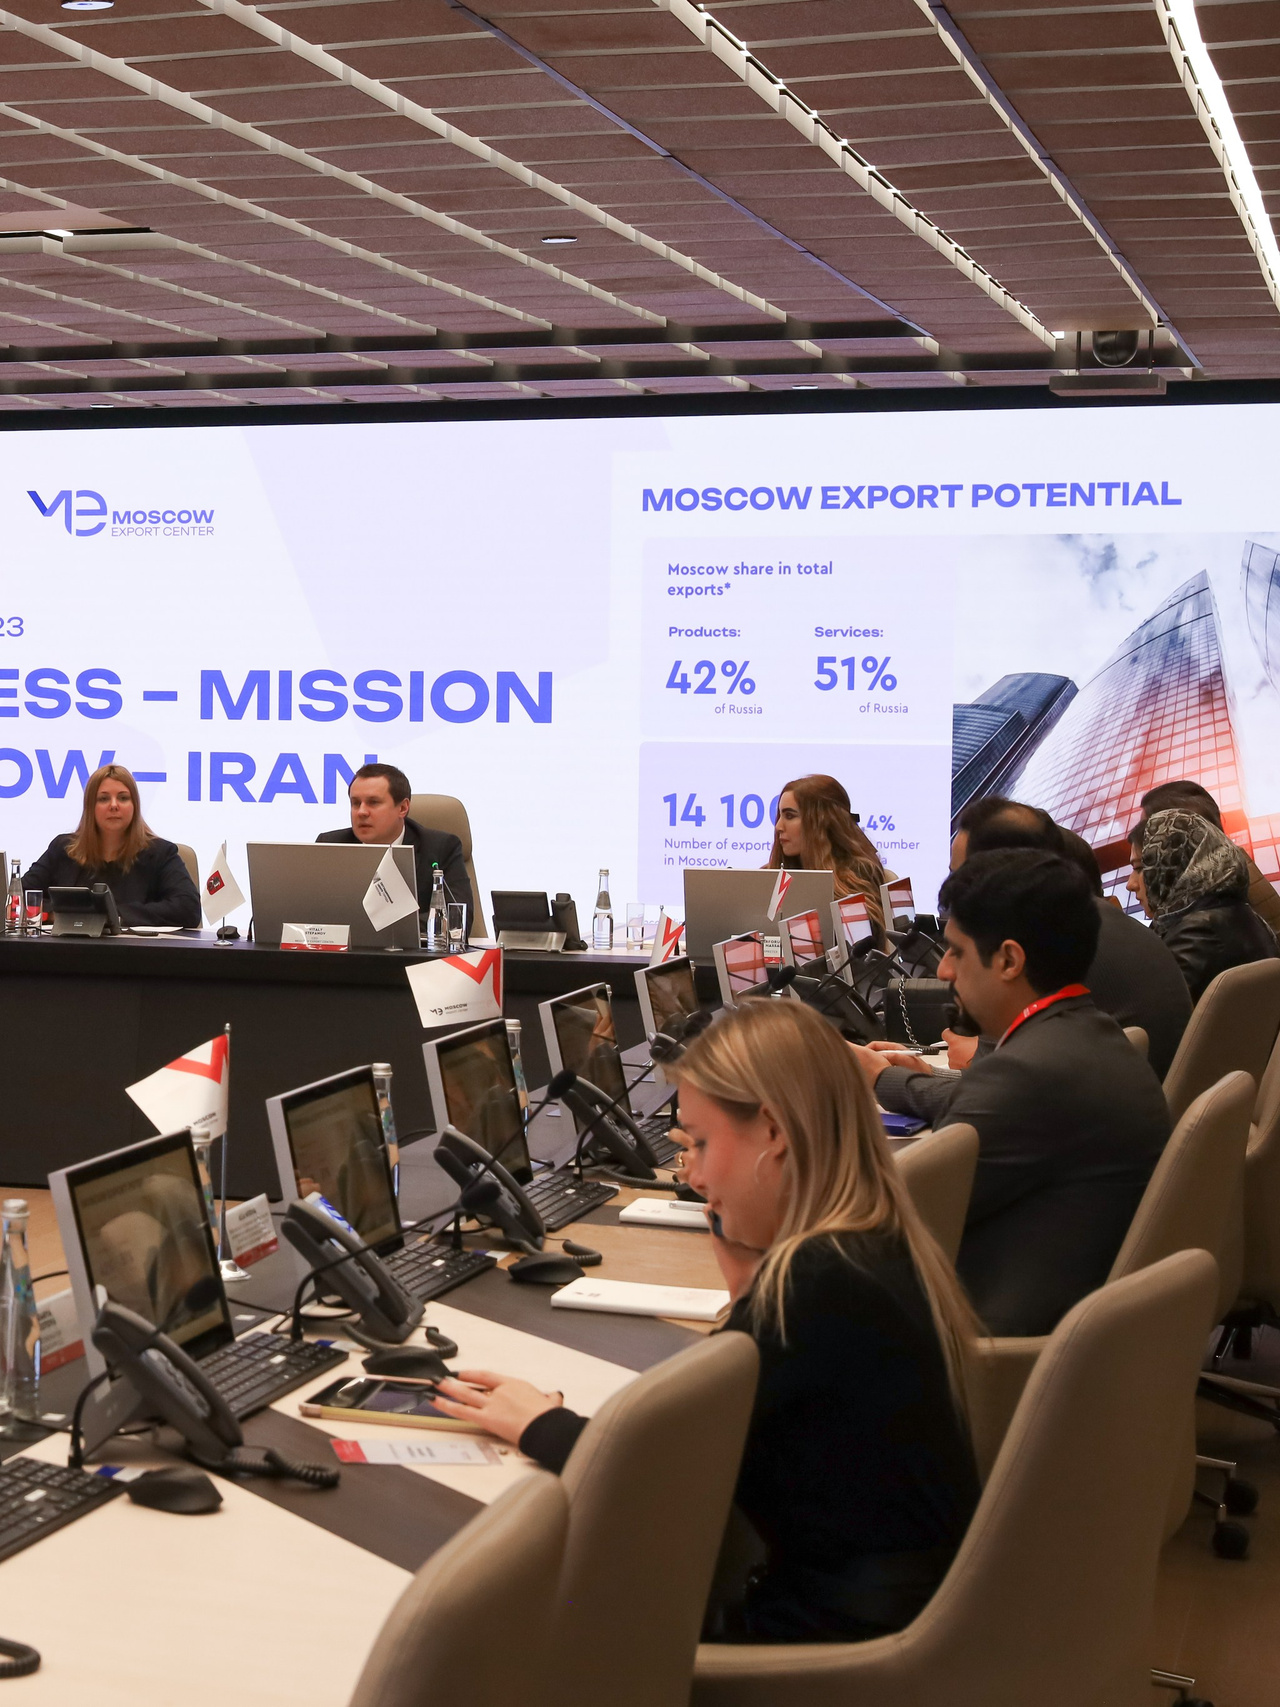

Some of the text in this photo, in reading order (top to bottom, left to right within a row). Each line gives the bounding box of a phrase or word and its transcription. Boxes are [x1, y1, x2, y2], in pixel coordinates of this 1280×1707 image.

[643, 481, 1182, 511] MOSCOW EXPORT POTENTIAL
[113, 510, 214, 524] MOSCOW
[112, 526, 214, 536] EXPORT CENTER
[669, 561, 832, 575] Moscow share in total
[669, 627, 740, 637] Products:
[815, 626, 883, 637] Services:
[666, 660, 755, 695] 42%
[814, 656, 897, 691] 51%
[200, 670, 552, 723] MISSION
[715, 703, 762, 714] of Russia
[859, 702, 908, 713] of Russia
[187, 750, 378, 805] IRAN
[663, 793, 706, 827] 14
[665, 838, 772, 853] Number of export
[665, 854, 728, 866] in Moscow
[444, 1002, 468, 1011] MOSCOW
[193, 1112, 217, 1126] MOSCOW
